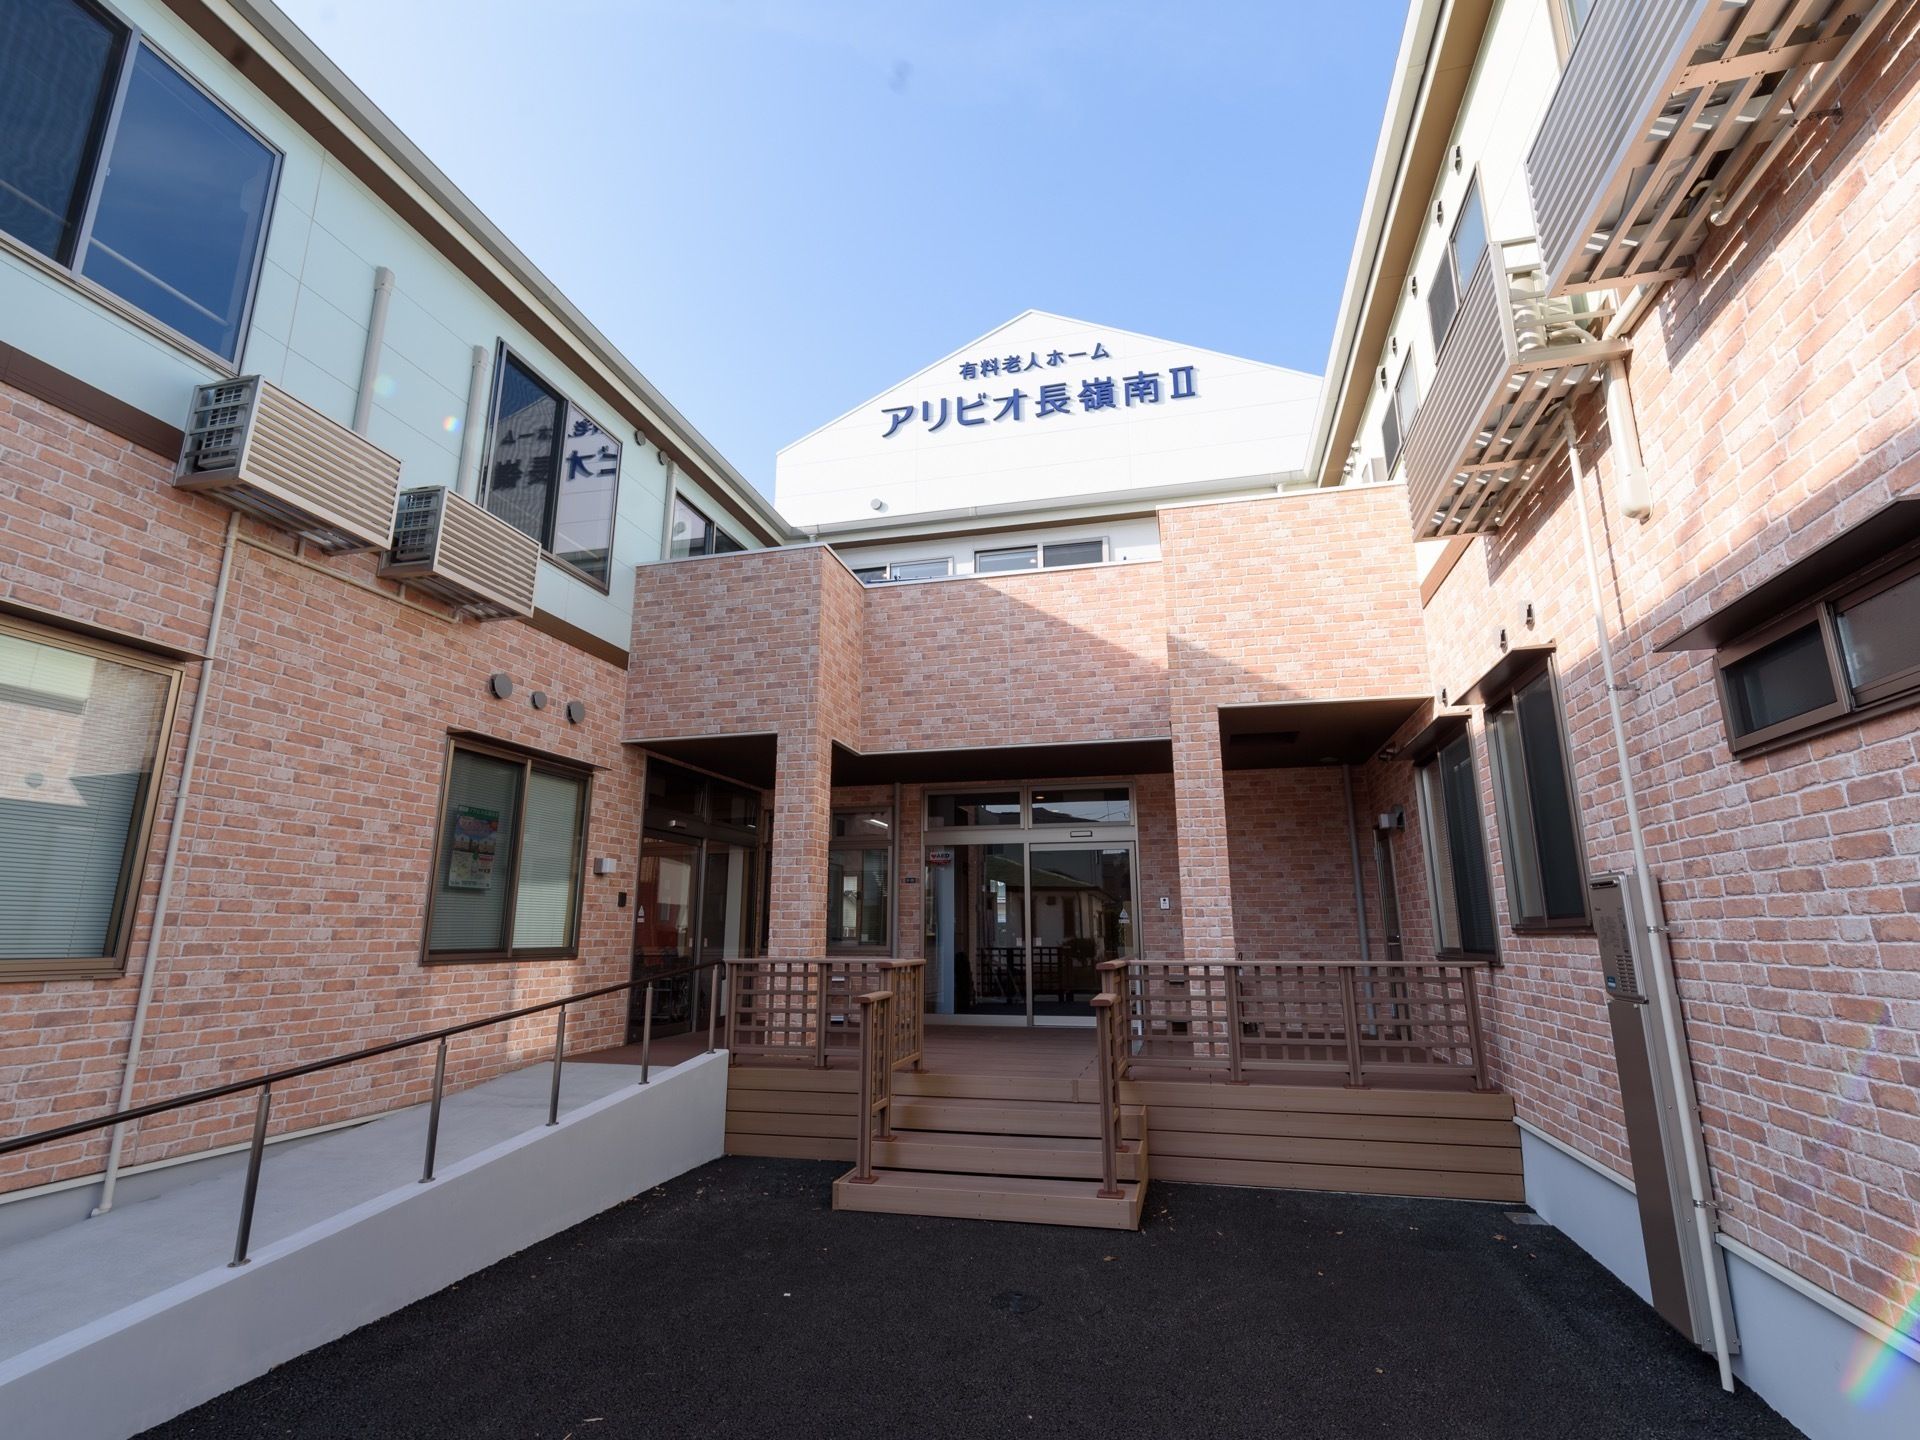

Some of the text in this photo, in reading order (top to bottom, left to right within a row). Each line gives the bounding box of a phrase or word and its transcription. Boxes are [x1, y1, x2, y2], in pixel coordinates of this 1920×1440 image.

[959, 342, 1110, 380] 有料老人ホーム
